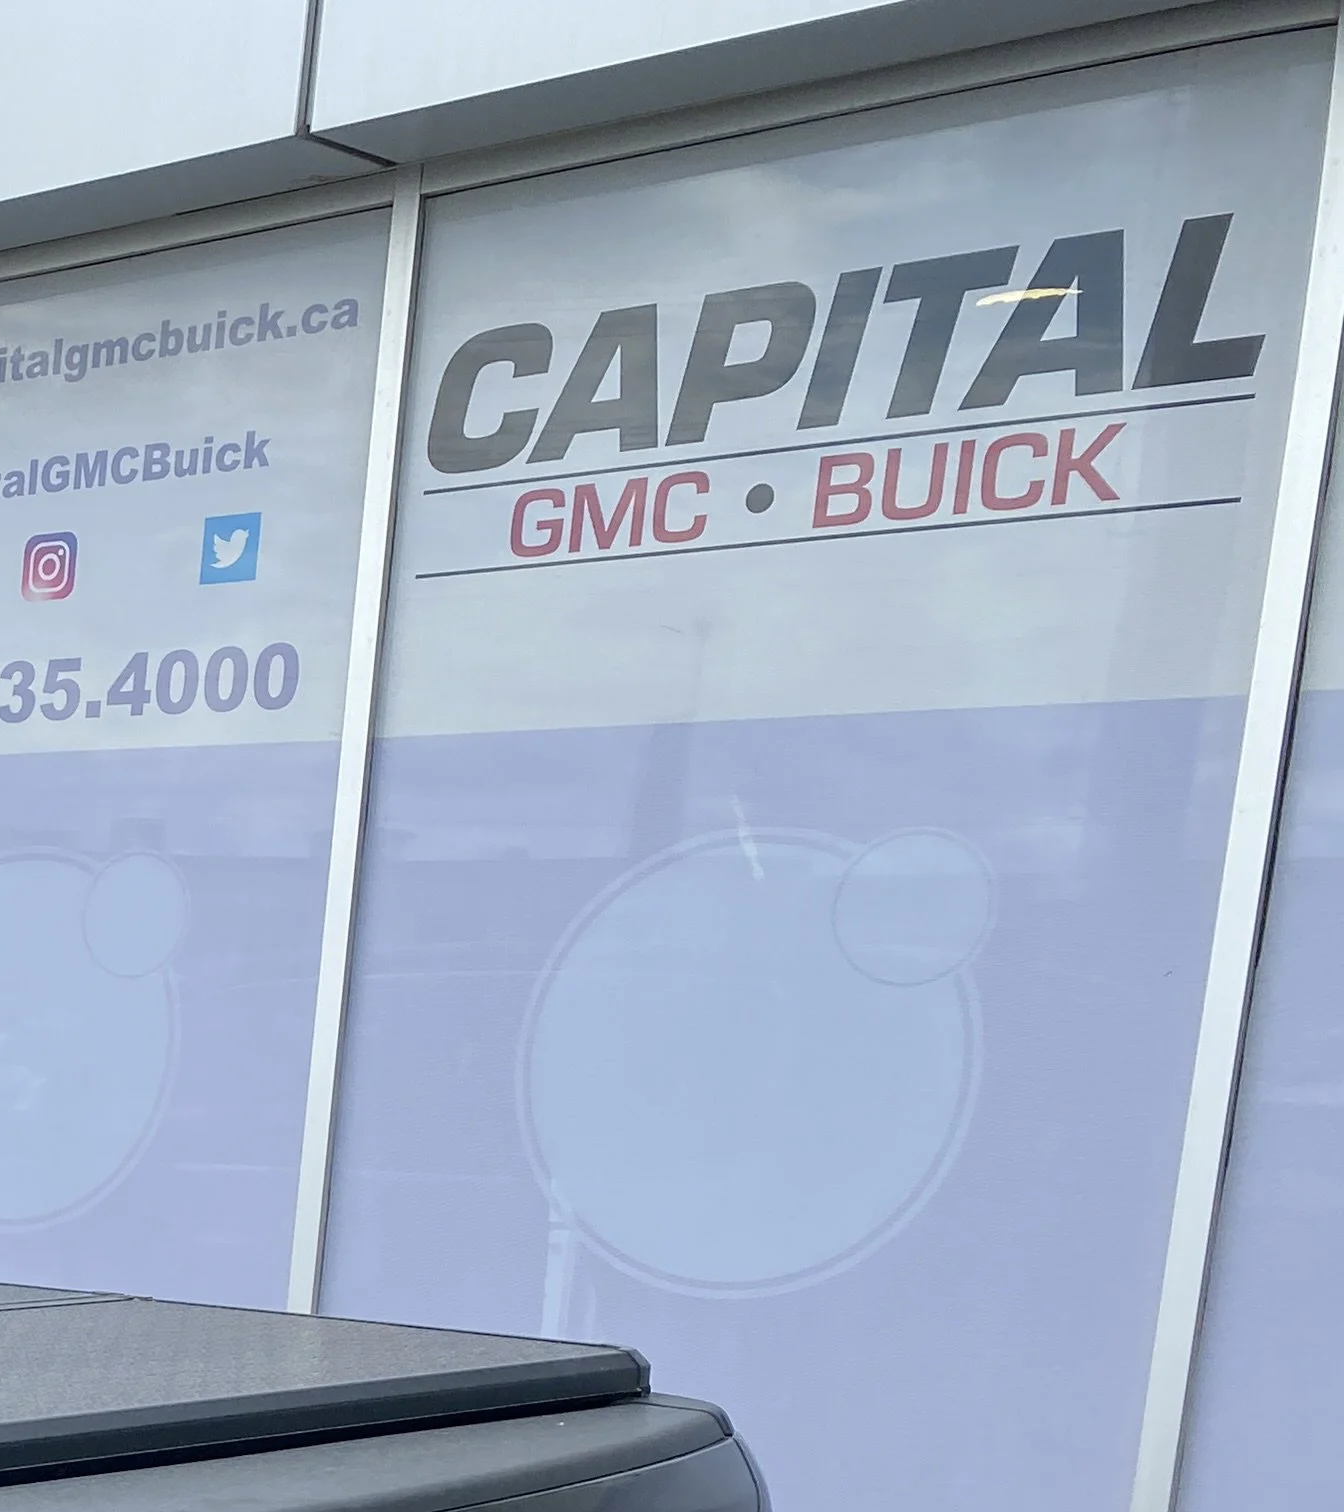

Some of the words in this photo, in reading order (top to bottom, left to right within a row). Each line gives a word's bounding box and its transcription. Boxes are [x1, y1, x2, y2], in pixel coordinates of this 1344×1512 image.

[427, 212, 1267, 474] CAPITAL
[510, 472, 710, 558] GMC
[812, 423, 1127, 529] BUICK
